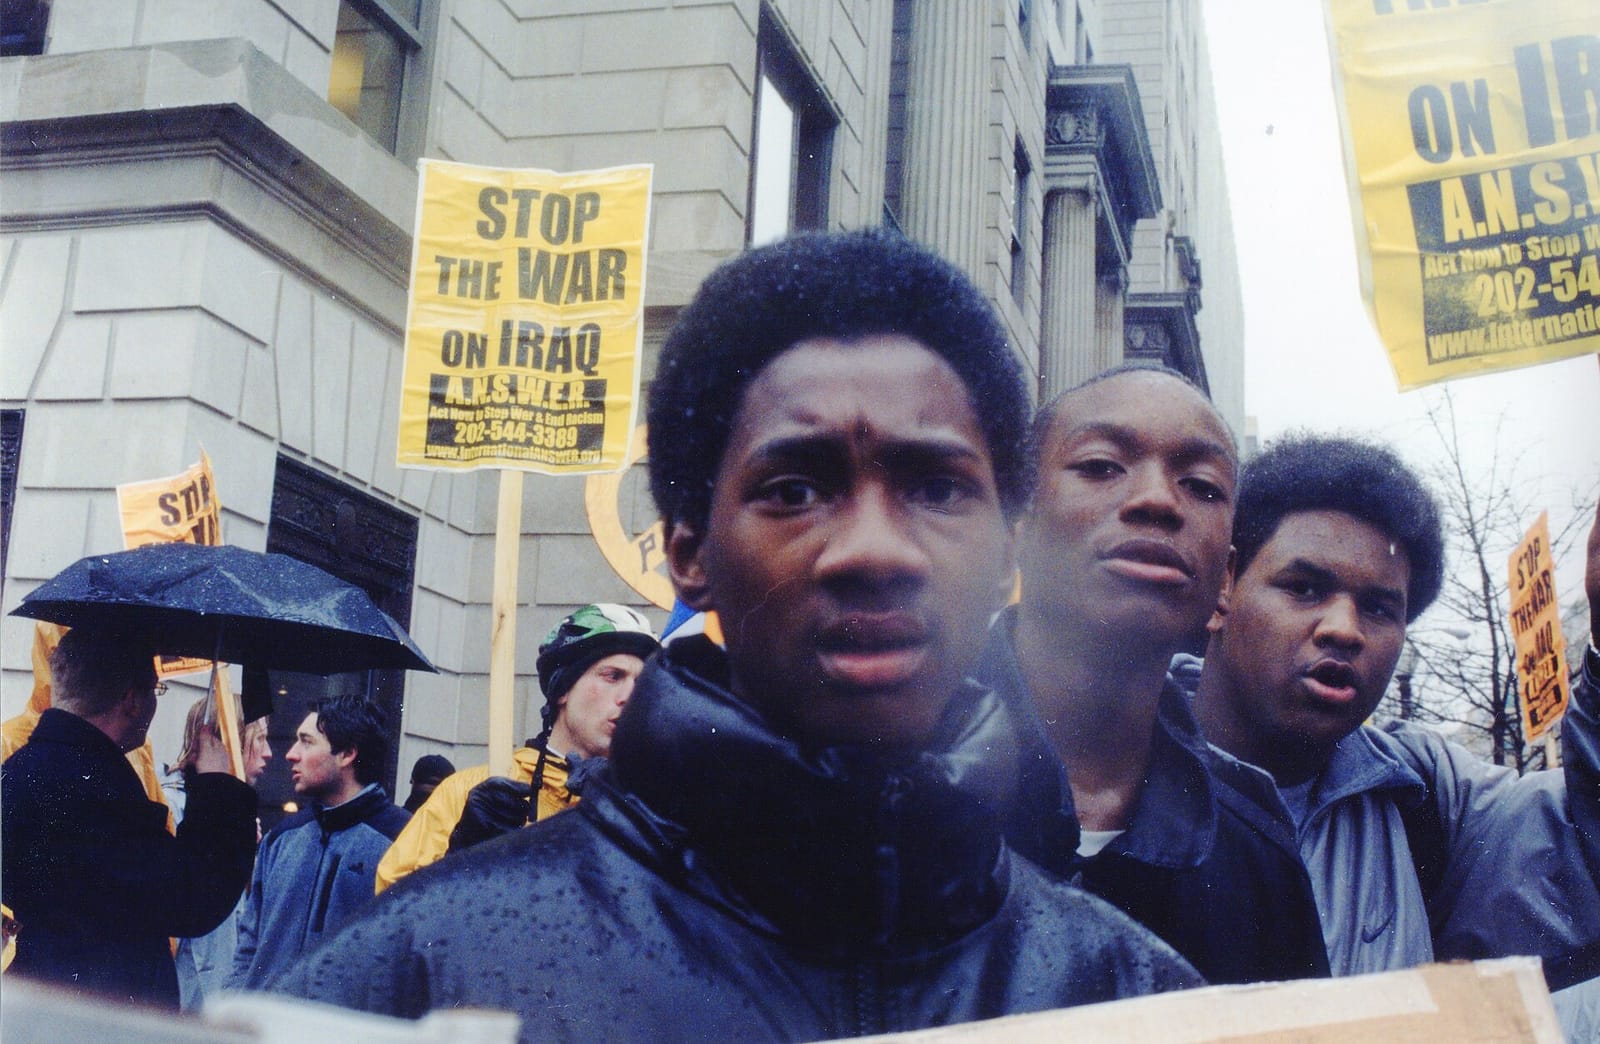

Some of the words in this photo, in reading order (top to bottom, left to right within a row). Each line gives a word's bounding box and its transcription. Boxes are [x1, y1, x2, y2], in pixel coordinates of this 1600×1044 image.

[1407, 78, 1497, 165] ON
[476, 186, 600, 246] STOP
[434, 254, 504, 301] THE
[517, 246, 628, 306] WAR
[1424, 253, 1459, 279] Act
[1458, 248, 1502, 273] Now
[1501, 243, 1523, 266] to
[1525, 233, 1580, 261] Stop
[1475, 254, 1600, 318] 202-54
[441, 329, 489, 369] ON
[498, 319, 602, 377] IRAQ
[430, 406, 449, 420] Act
[450, 407, 475, 422] Now
[485, 406, 509, 420] Stop
[511, 406, 535, 421] War
[535, 411, 544, 424] &
[545, 411, 565, 427] End
[565, 411, 604, 426] Racism
[444, 373, 591, 411] A.N.S.W.E.R.
[454, 420, 578, 449] 202-544-3389
[1517, 536, 1542, 591] STOP
[1512, 602, 1534, 637] THE
[1531, 569, 1554, 618] WAR
